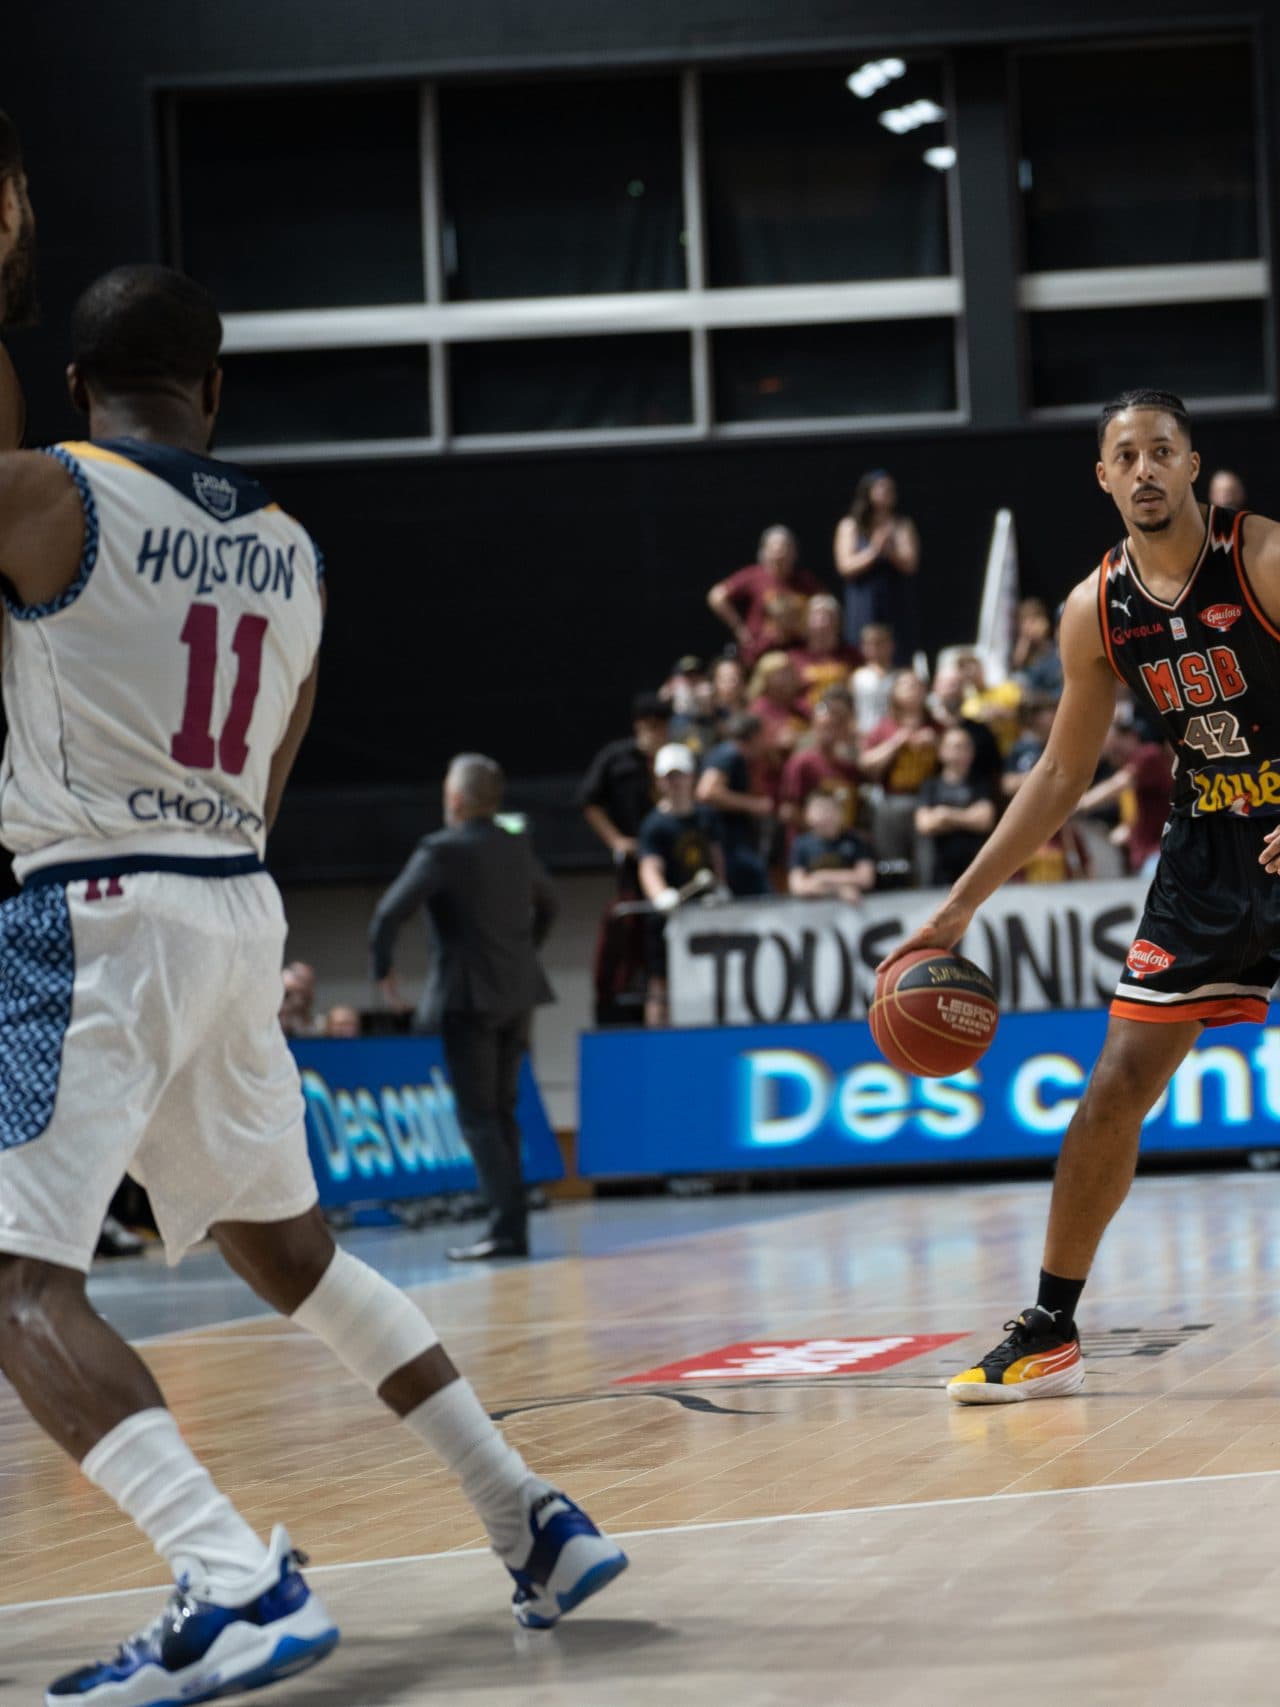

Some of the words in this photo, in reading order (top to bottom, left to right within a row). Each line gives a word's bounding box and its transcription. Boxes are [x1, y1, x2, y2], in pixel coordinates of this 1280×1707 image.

[136, 527, 296, 600] HOLSTON
[1207, 606, 1241, 624] Gaulois
[171, 602, 269, 776] 11
[1139, 645, 1248, 715] MSB
[1183, 710, 1251, 759] 42
[937, 995, 996, 1025] LEGACY
[745, 1047, 982, 1147] Des
